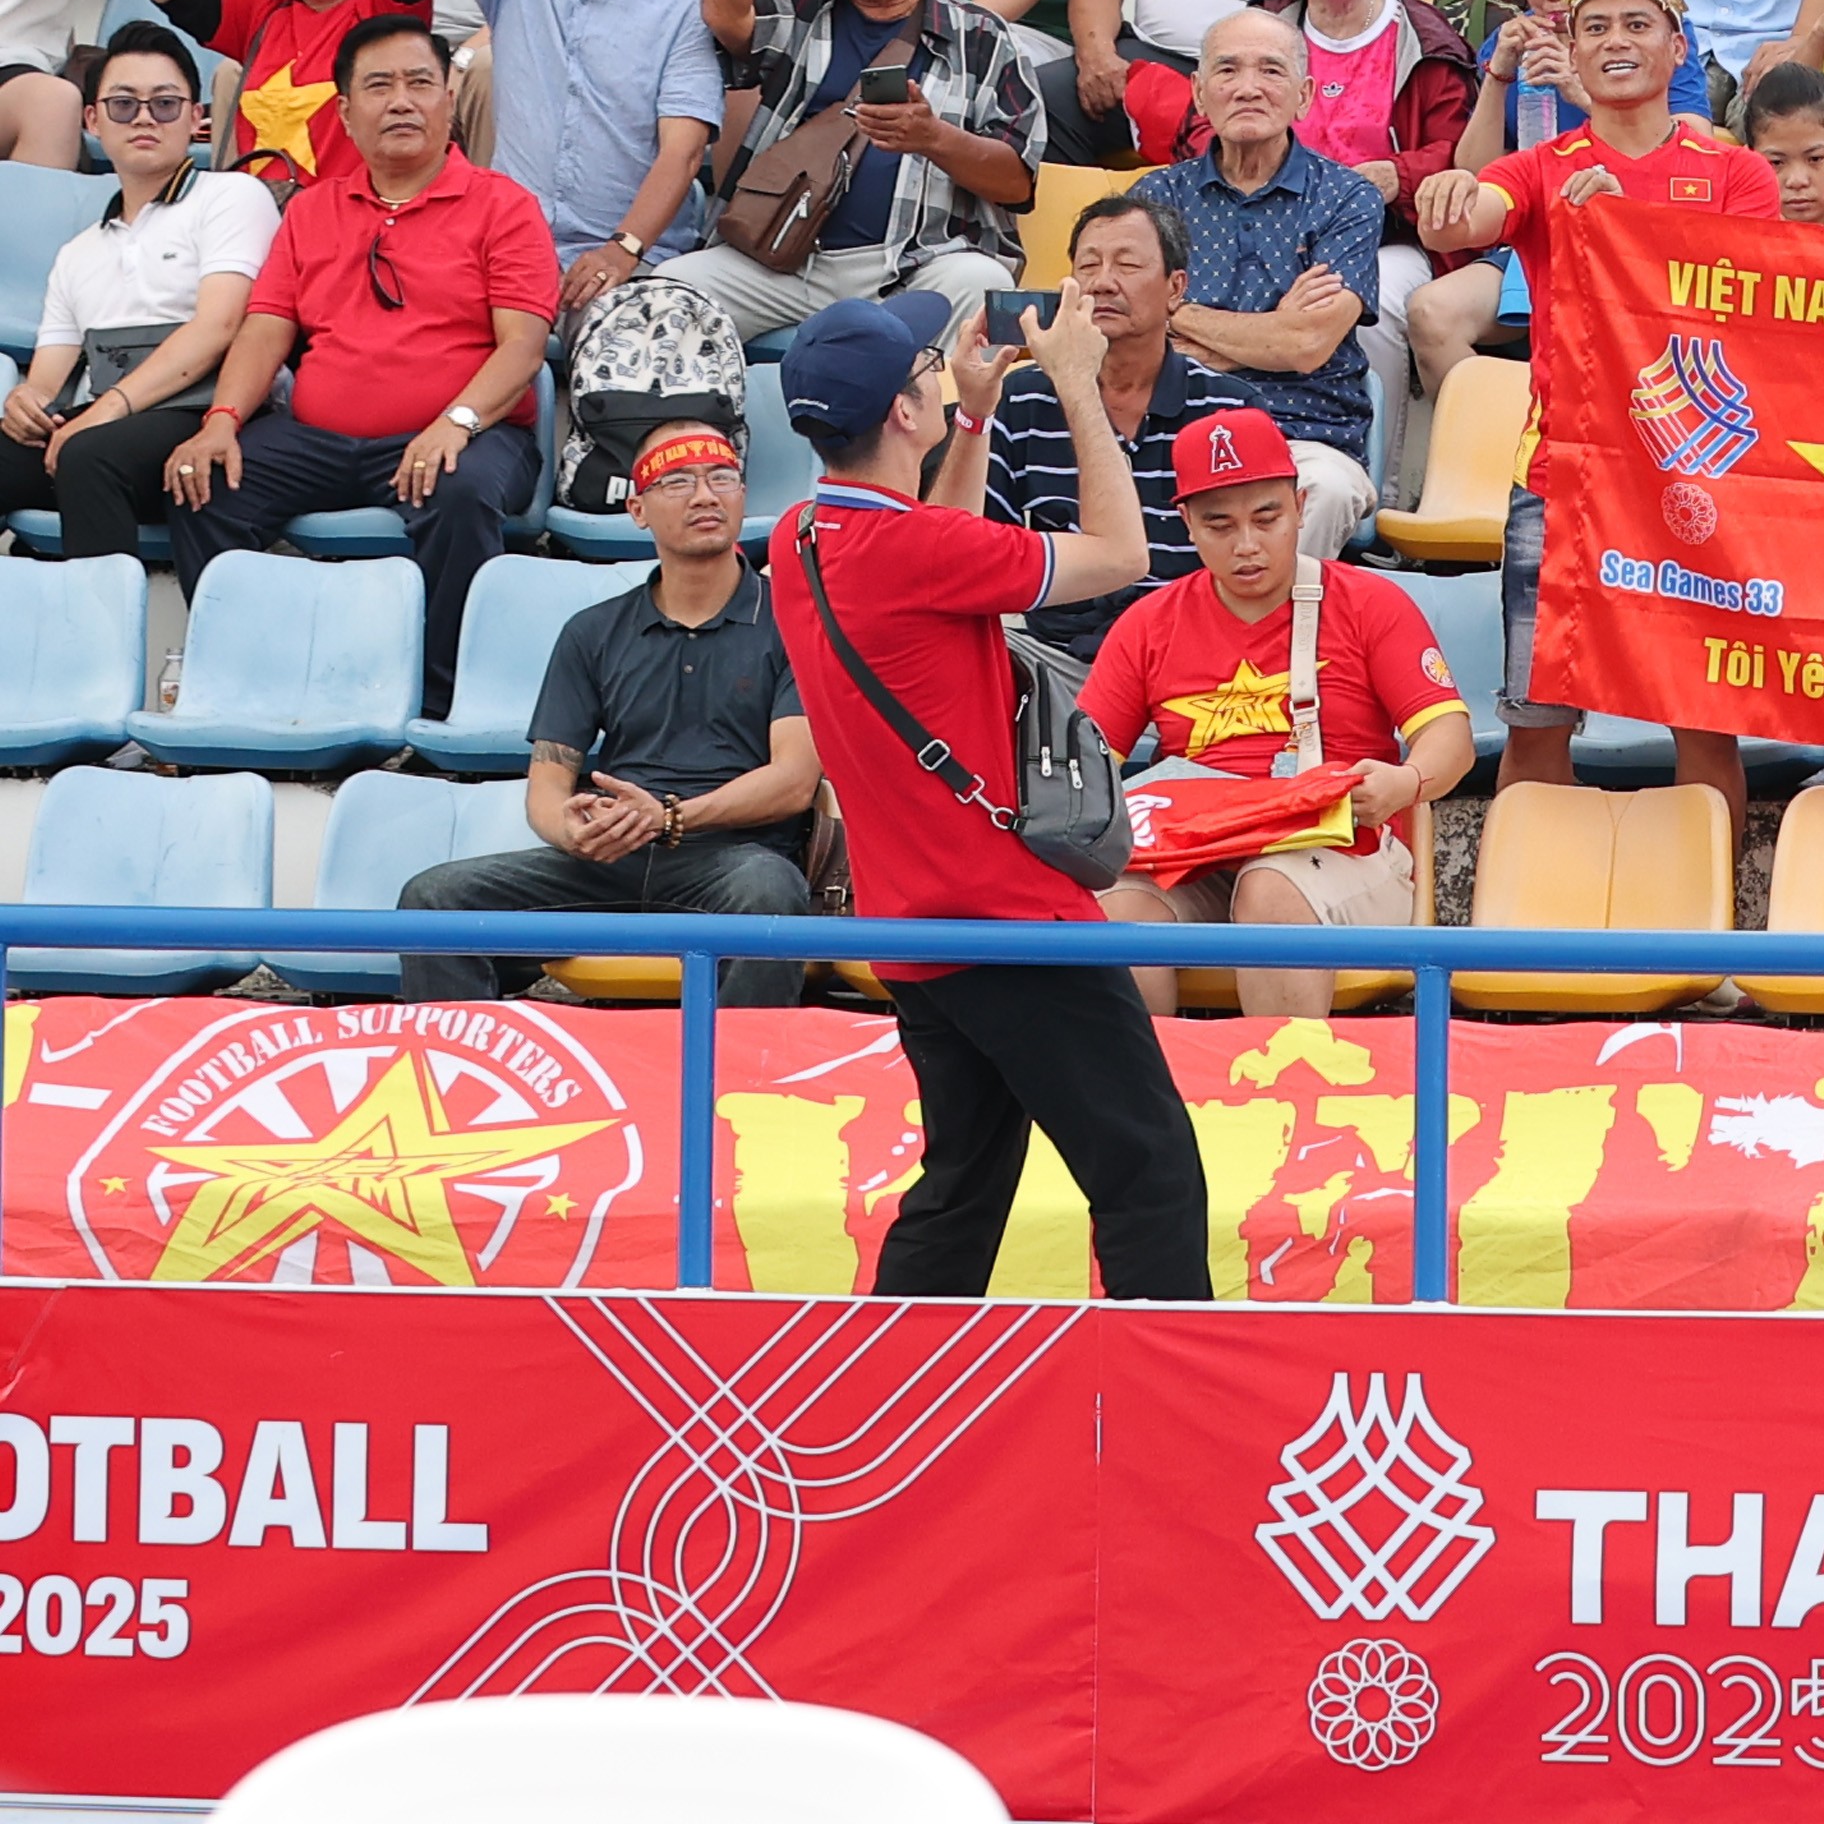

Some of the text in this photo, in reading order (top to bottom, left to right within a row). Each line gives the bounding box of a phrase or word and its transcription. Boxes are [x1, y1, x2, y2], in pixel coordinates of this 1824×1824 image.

[1667, 257, 1763, 324] VIỆT
[1209, 425, 1243, 473] A
[1599, 549, 1785, 618] Sea Games 33
[1704, 637, 1764, 689] Tôi
[141, 1004, 582, 1138] FOOTBALL SUPPORTERS
[0, 1575, 191, 1659] 2025
